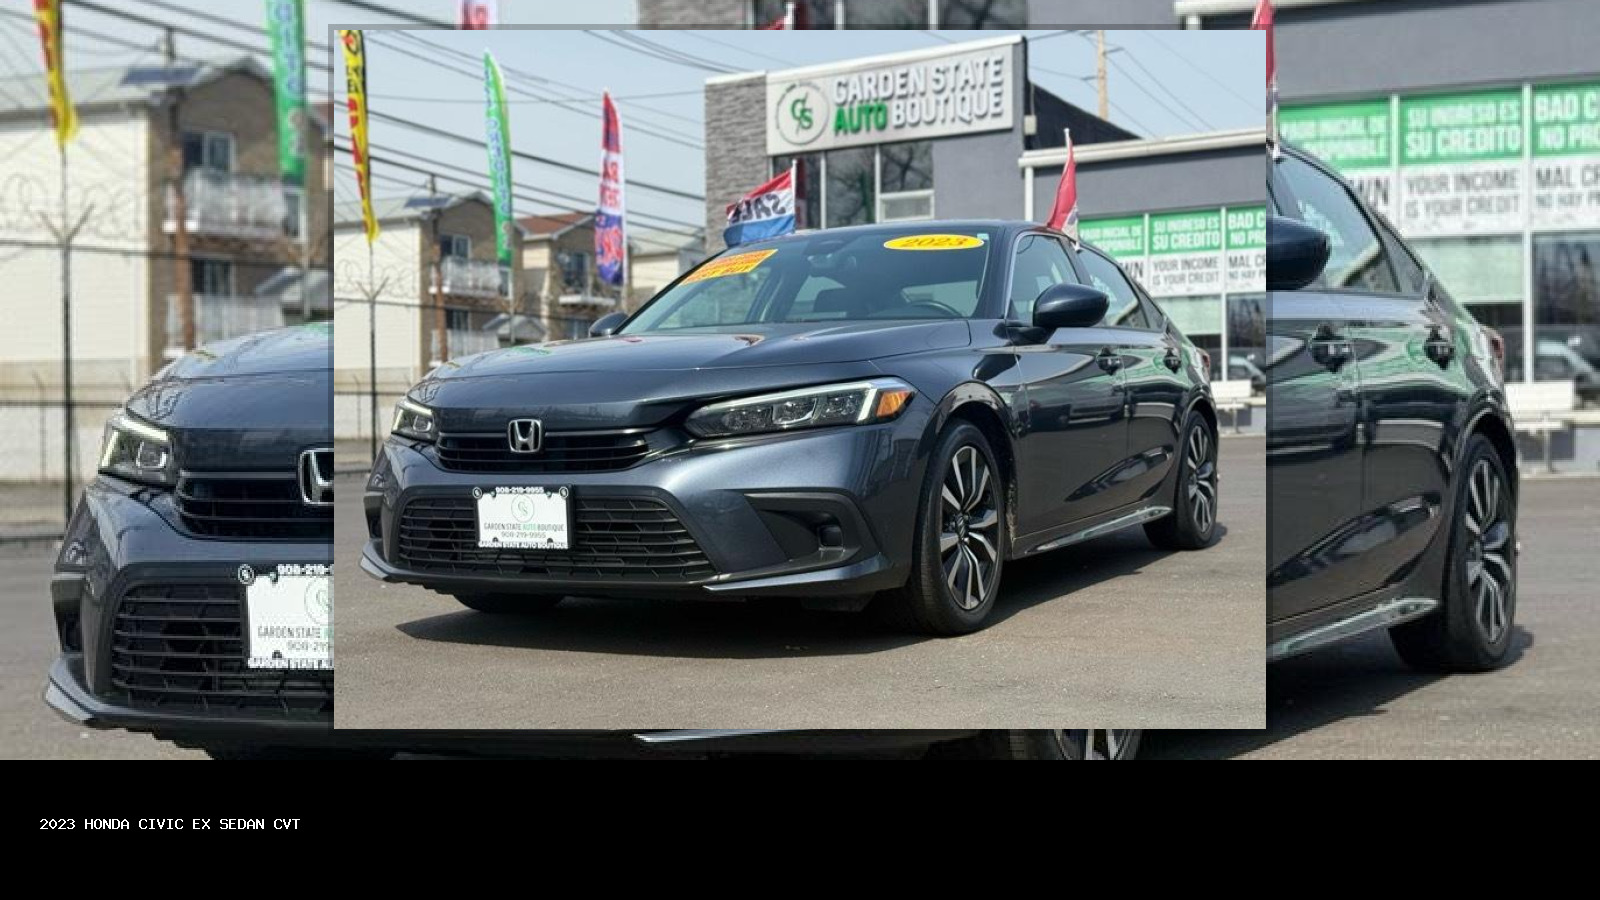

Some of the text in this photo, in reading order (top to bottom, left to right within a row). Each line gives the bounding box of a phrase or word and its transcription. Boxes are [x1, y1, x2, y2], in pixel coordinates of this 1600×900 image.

[834, 56, 1003, 105] GARDEN STATE
[834, 87, 1003, 136] AUTO BOUTIQUE
[1536, 93, 1579, 122] BAD
[1406, 125, 1521, 158] SU CREDITO
[1538, 125, 1565, 149] NO
[1406, 169, 1516, 195] YOUR INCOME
[1536, 166, 1575, 189] MAL
[1424, 198, 1462, 217] YOUR
[1467, 195, 1518, 215] CREDIT
[1153, 220, 1166, 233] SU
[1228, 212, 1253, 230] BAD
[901, 236, 969, 248] 2023
[1152, 230, 1220, 250] SU CREDITO
[1230, 230, 1246, 246] NO
[1153, 256, 1218, 272] YOUR INCOME
[1228, 254, 1251, 268] MAL
[1152, 271, 1219, 285] IS YOUR CREDIT
[484, 523, 506, 531] GARDEN
[506, 523, 521, 531] STATE
[537, 523, 564, 532] BOUTIQUE
